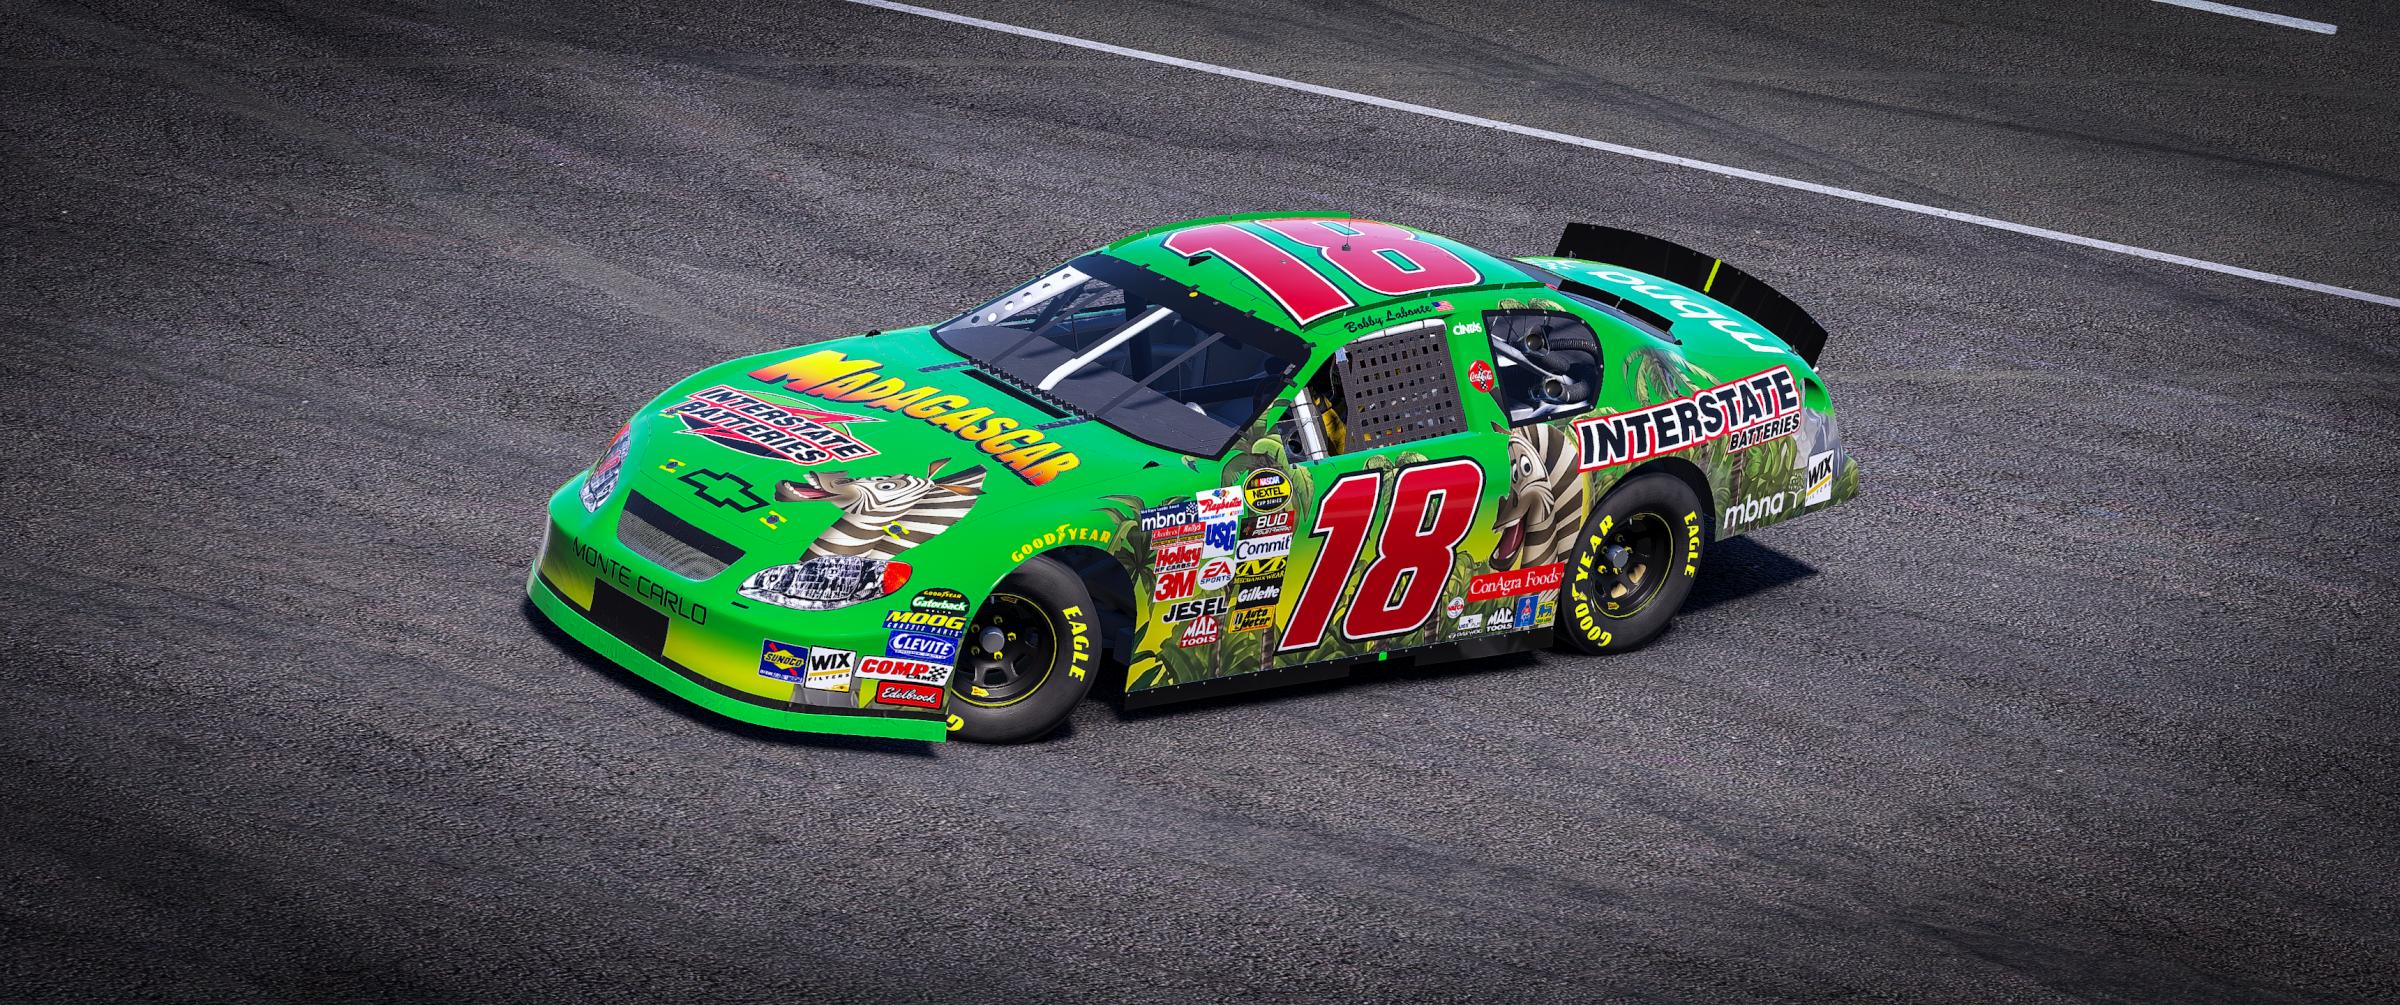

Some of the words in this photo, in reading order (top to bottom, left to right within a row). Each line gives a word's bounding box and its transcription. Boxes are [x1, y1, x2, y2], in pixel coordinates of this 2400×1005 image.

[1161, 218, 1485, 326] 18
[1344, 314, 1384, 333] Bobby
[1385, 305, 1432, 321] Labonte
[1586, 271, 1787, 354] mbna
[698, 388, 868, 458] INTERSTATE
[747, 350, 1081, 487] MADAGASCAR
[1581, 367, 1798, 465] INTERSTATE
[678, 401, 827, 462] BATTERIES
[1730, 413, 1800, 451] BATTERIES
[1259, 475, 1280, 486] NASCAR
[1808, 454, 1832, 488] WIX
[1252, 487, 1285, 499] NEXTEL
[1256, 512, 1289, 529] BUD
[1723, 491, 1785, 529] mbna
[1141, 511, 1187, 531] mbna
[1205, 520, 1237, 552] USG
[1683, 511, 1700, 578] EAGLE
[1156, 546, 1201, 567] Holley
[1236, 535, 1290, 560] Commit
[1274, 456, 1486, 655] 18
[572, 536, 632, 588] MONTE
[637, 576, 707, 625] CARLO
[1200, 575, 1232, 585] SPORTS
[1203, 561, 1231, 579] EA
[1155, 569, 1197, 601] 3M
[1471, 577, 1521, 596] ConAgra
[1526, 568, 1561, 587] Foods
[912, 596, 968, 612] Gatorback
[1238, 584, 1281, 603] Gillette
[886, 611, 967, 630] MOOG
[1163, 597, 1228, 623] JESEL
[1245, 608, 1269, 619] Auto
[1487, 607, 1513, 626] MAC
[887, 622, 925, 632] CHASSIS
[931, 626, 961, 638] PARTS
[1183, 616, 1218, 639] MAC
[1486, 623, 1513, 632] TOOLS
[893, 633, 953, 655] CLEVITE
[1062, 605, 1090, 682] EAGLE
[1181, 635, 1217, 647] TOOLS
[766, 653, 803, 667] SUNOCO
[811, 652, 851, 671] WIX
[861, 659, 930, 677] COMP
[808, 672, 850, 682] FILTERS
[906, 673, 939, 682] CAMS
[881, 686, 937, 704] Edelbrock
